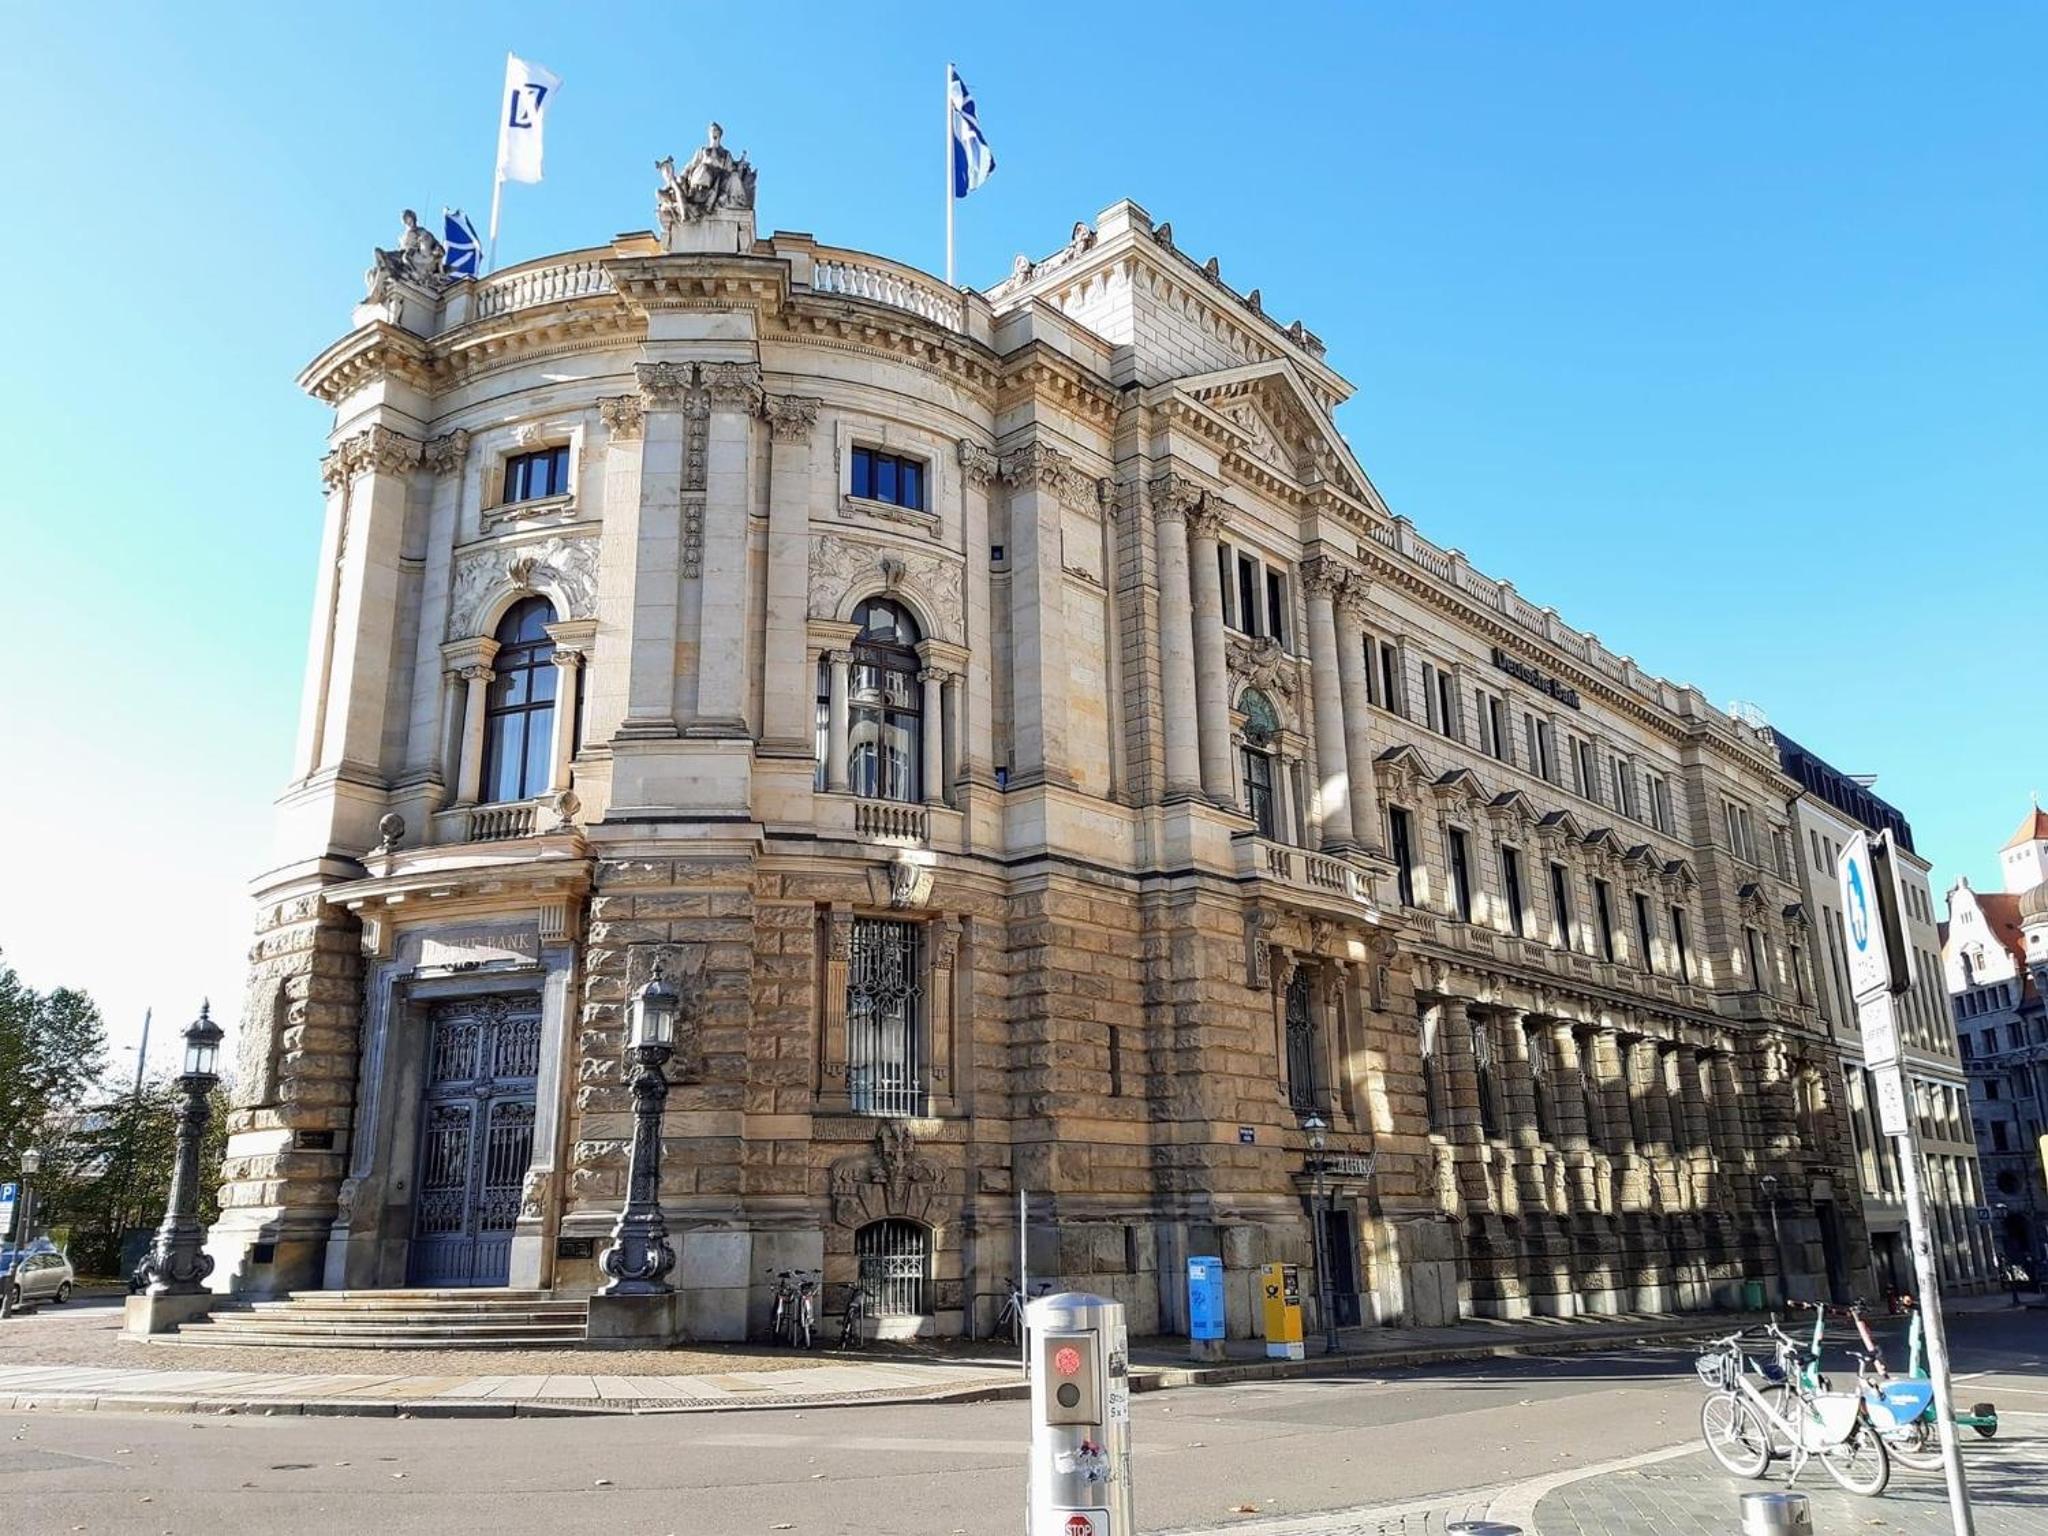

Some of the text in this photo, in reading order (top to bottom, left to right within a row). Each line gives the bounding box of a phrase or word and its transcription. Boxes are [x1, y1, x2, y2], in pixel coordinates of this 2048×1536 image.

[1498, 646, 1552, 696] Deutsche
[3, 1186, 12, 1201] P
[1065, 1524, 1092, 1536] STOP
